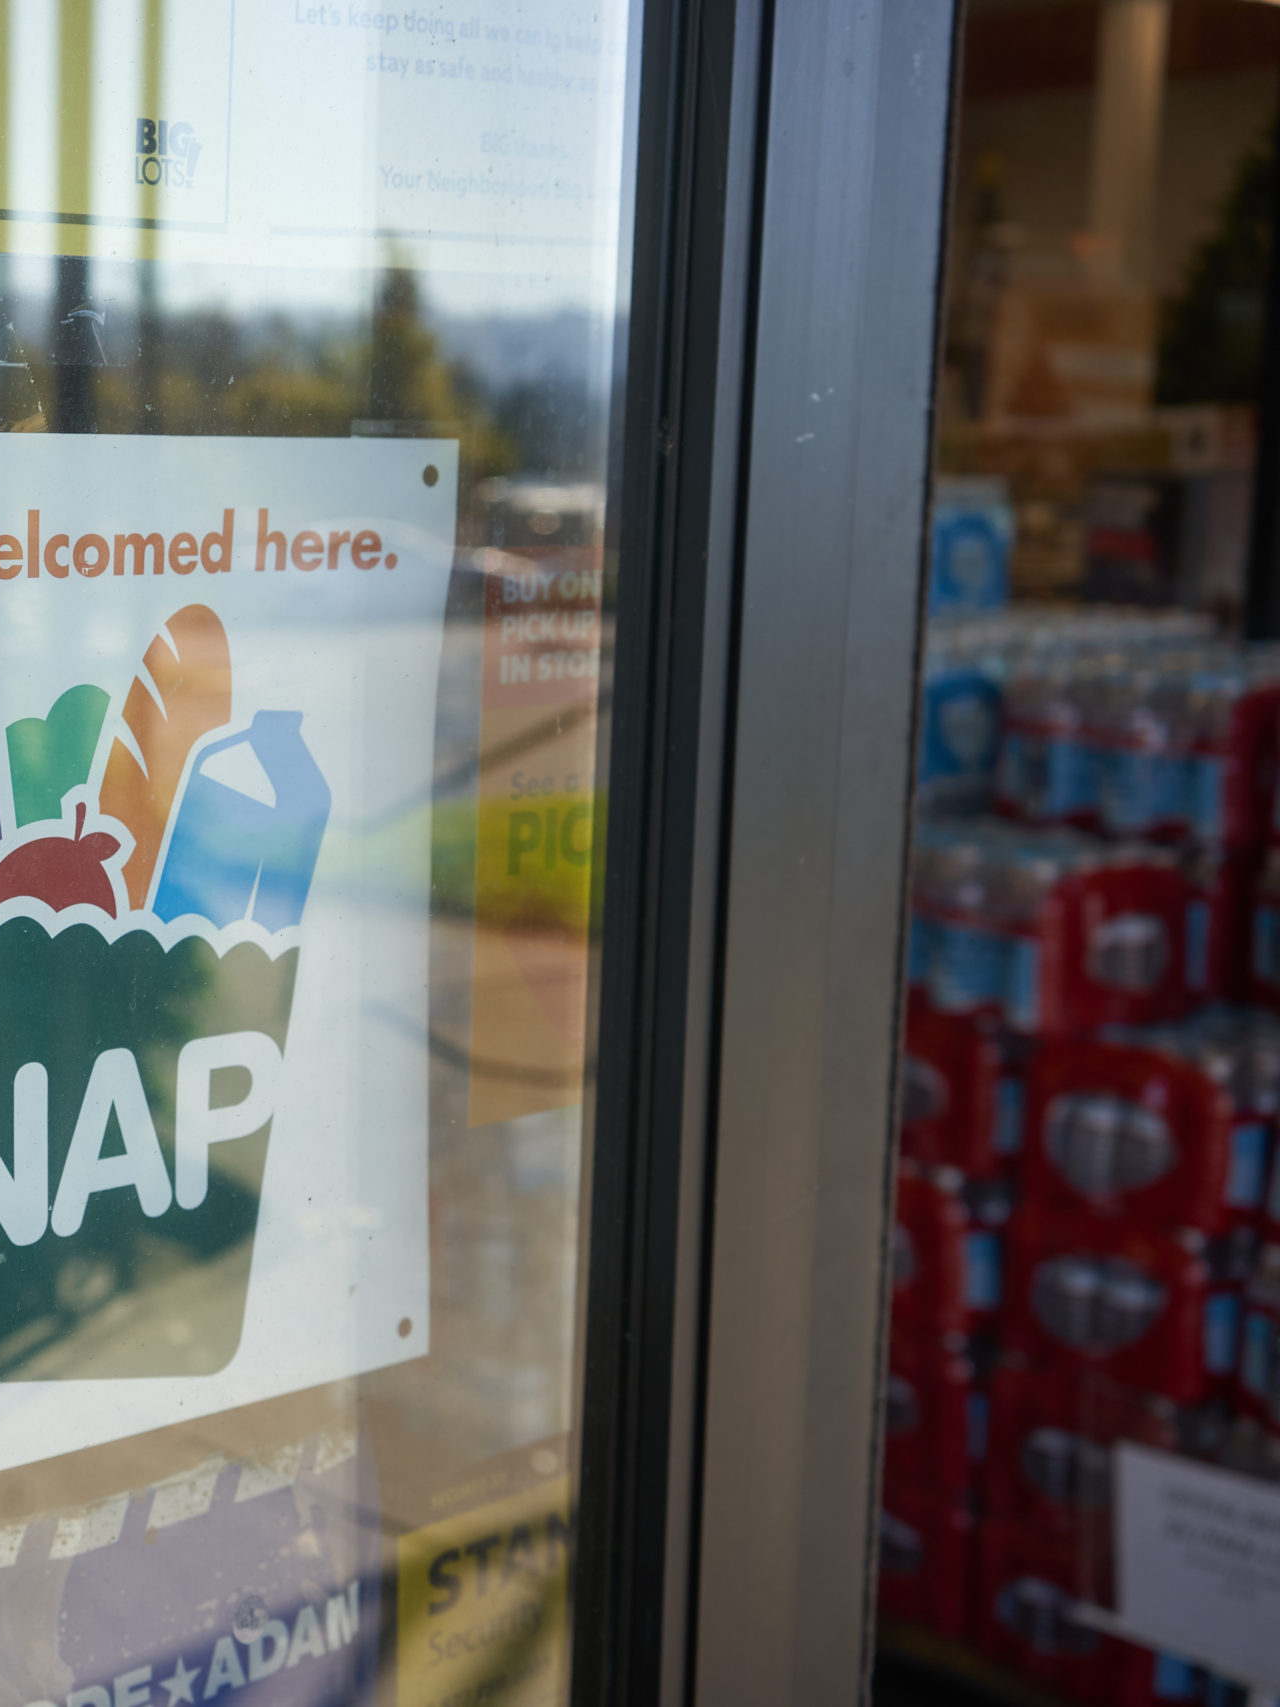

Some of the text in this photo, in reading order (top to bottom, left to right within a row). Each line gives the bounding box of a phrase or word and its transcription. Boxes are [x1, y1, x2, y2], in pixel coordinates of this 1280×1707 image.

[348, 5, 480, 42] keep doing all
[367, 54, 475, 80] stay as safe
[136, 117, 195, 157] BIG
[135, 143, 203, 189] LOTS!
[378, 165, 423, 190] Your
[254, 508, 400, 572] here.
[502, 573, 554, 605] BUY
[501, 615, 557, 644] PICK
[499, 655, 531, 685] IN
